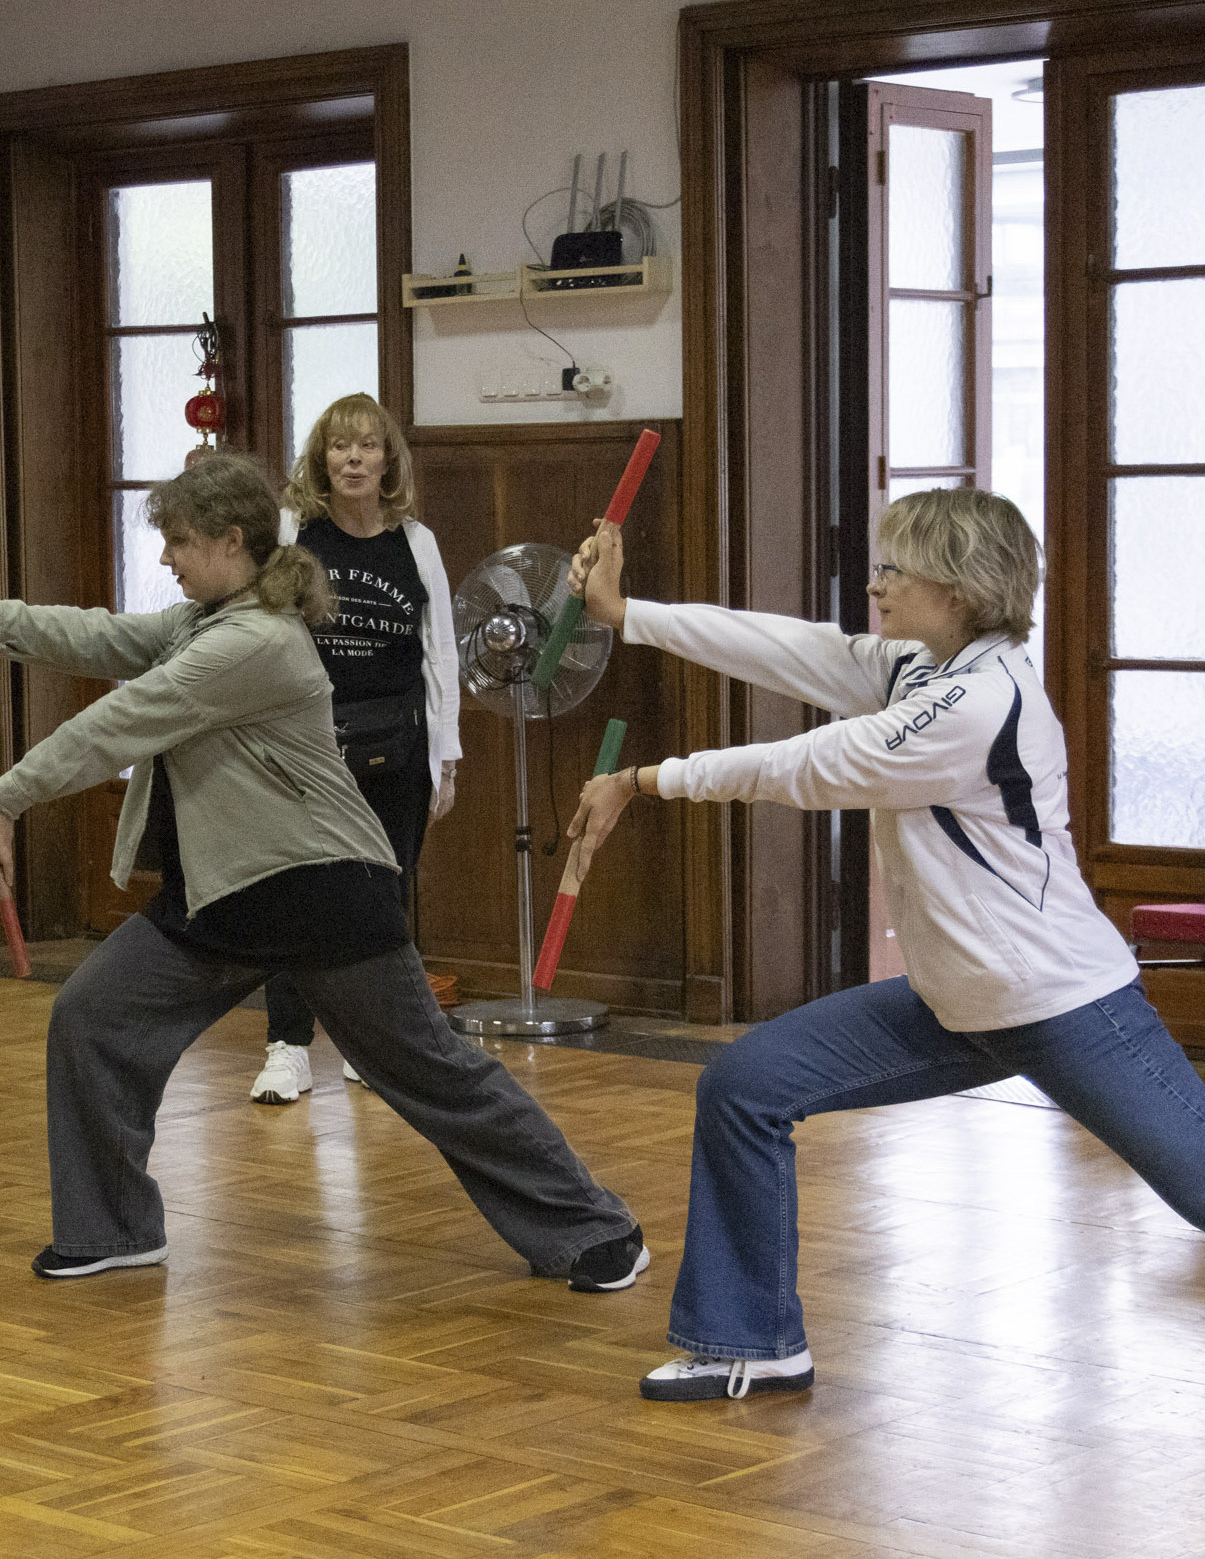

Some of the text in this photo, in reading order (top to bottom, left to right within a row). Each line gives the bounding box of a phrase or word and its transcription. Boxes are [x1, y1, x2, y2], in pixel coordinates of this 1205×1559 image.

[348, 568, 414, 615] FEMME
[317, 637, 330, 645] LA
[332, 638, 372, 647] PASSION
[331, 648, 345, 657] LA
[884, 685, 967, 751] GIVOVA
